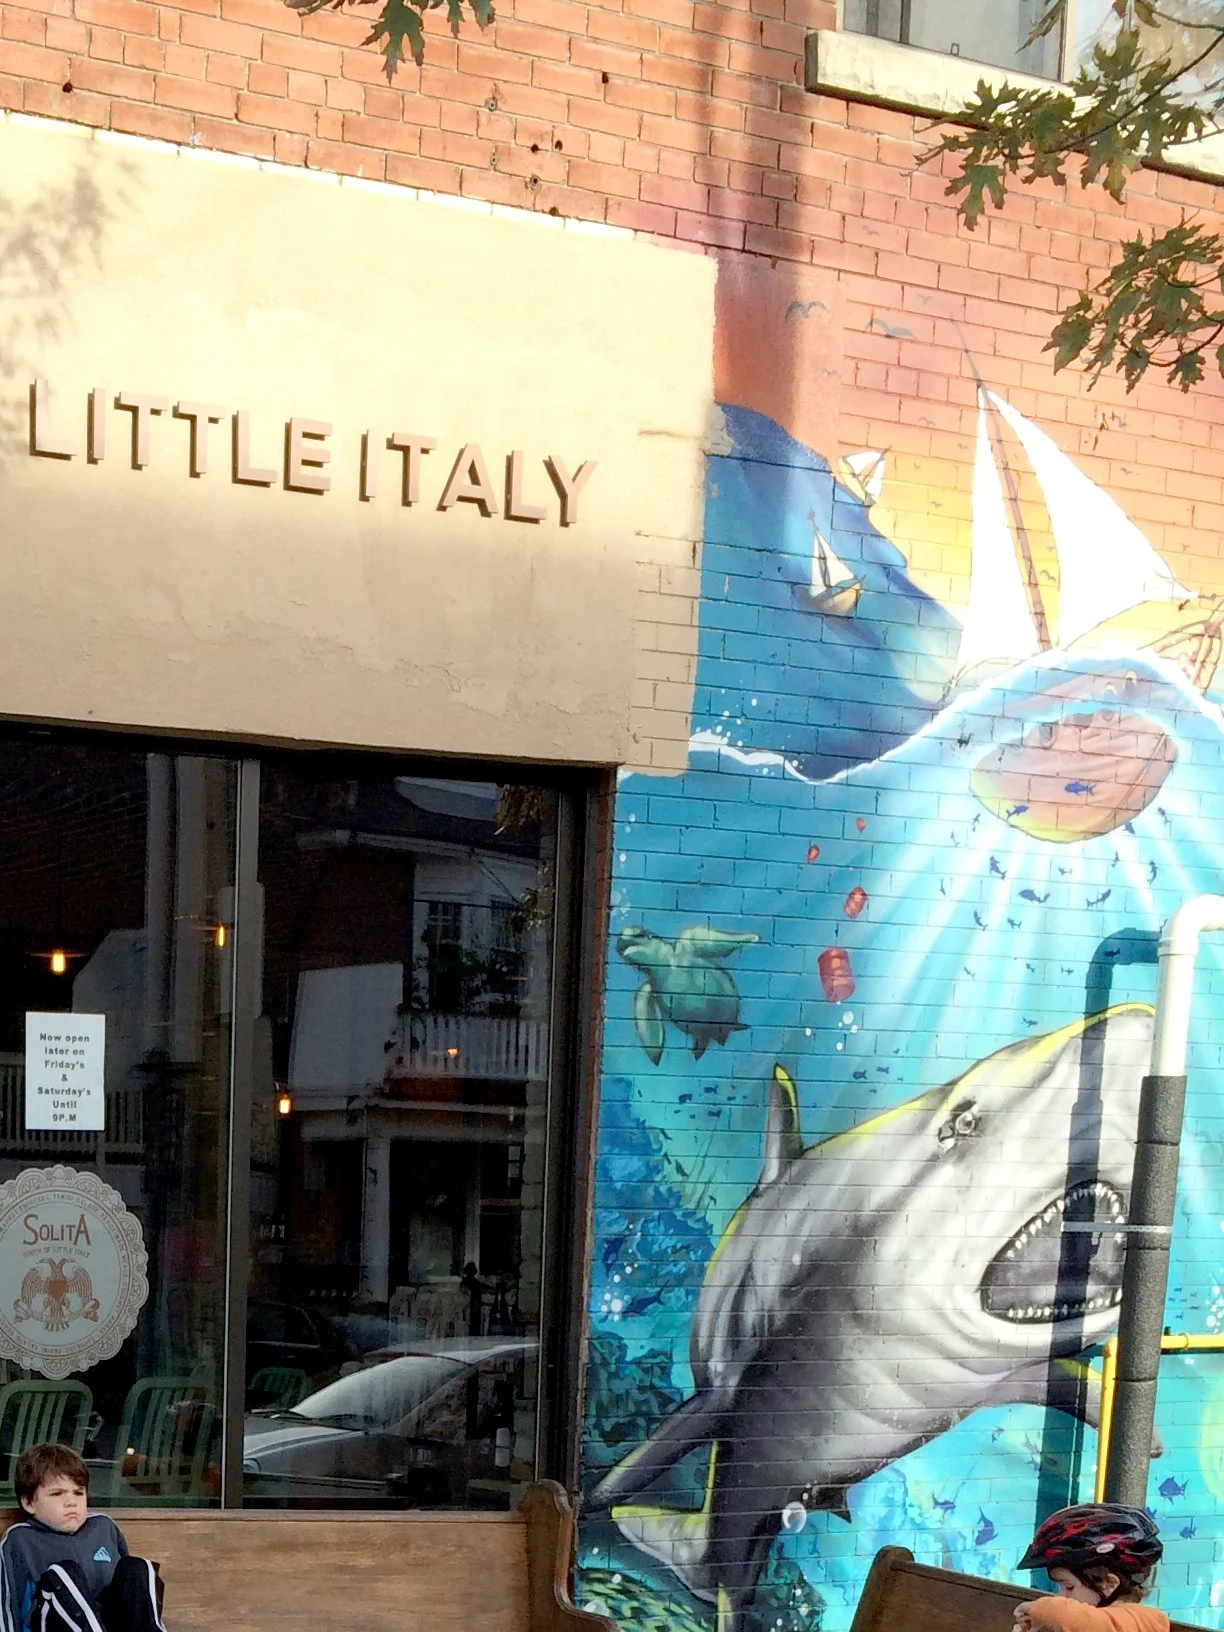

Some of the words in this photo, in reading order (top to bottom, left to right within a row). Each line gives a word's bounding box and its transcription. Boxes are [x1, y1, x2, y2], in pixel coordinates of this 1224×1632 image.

[29, 378, 332, 496] LITTLE
[359, 428, 599, 528] ITALY
[39, 1033, 62, 1041] Now
[66, 1035, 90, 1043] open
[44, 1047, 69, 1055] later
[44, 1060, 85, 1070] Friday's
[37, 1086, 91, 1097] Saturday's
[52, 1100, 77, 1108] Until
